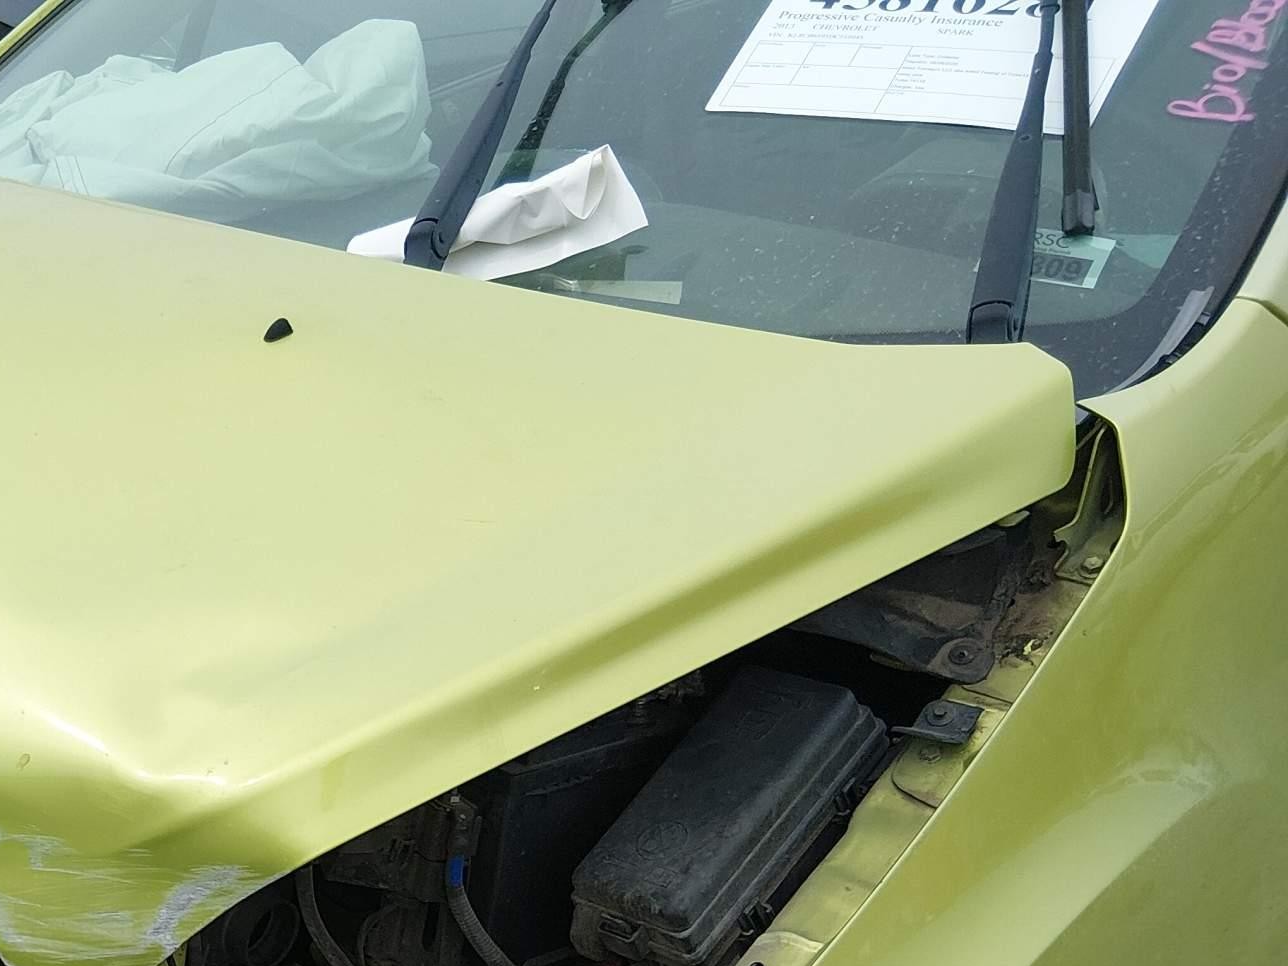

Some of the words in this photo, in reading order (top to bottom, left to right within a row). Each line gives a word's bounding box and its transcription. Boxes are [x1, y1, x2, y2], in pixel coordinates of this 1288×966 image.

[778, 10, 861, 22] Progressive
[863, 12, 926, 25] Casualty
[930, 15, 1003, 27] Insurance
[812, 22, 880, 32] CHEVROLET
[936, 27, 975, 36] SPARK
